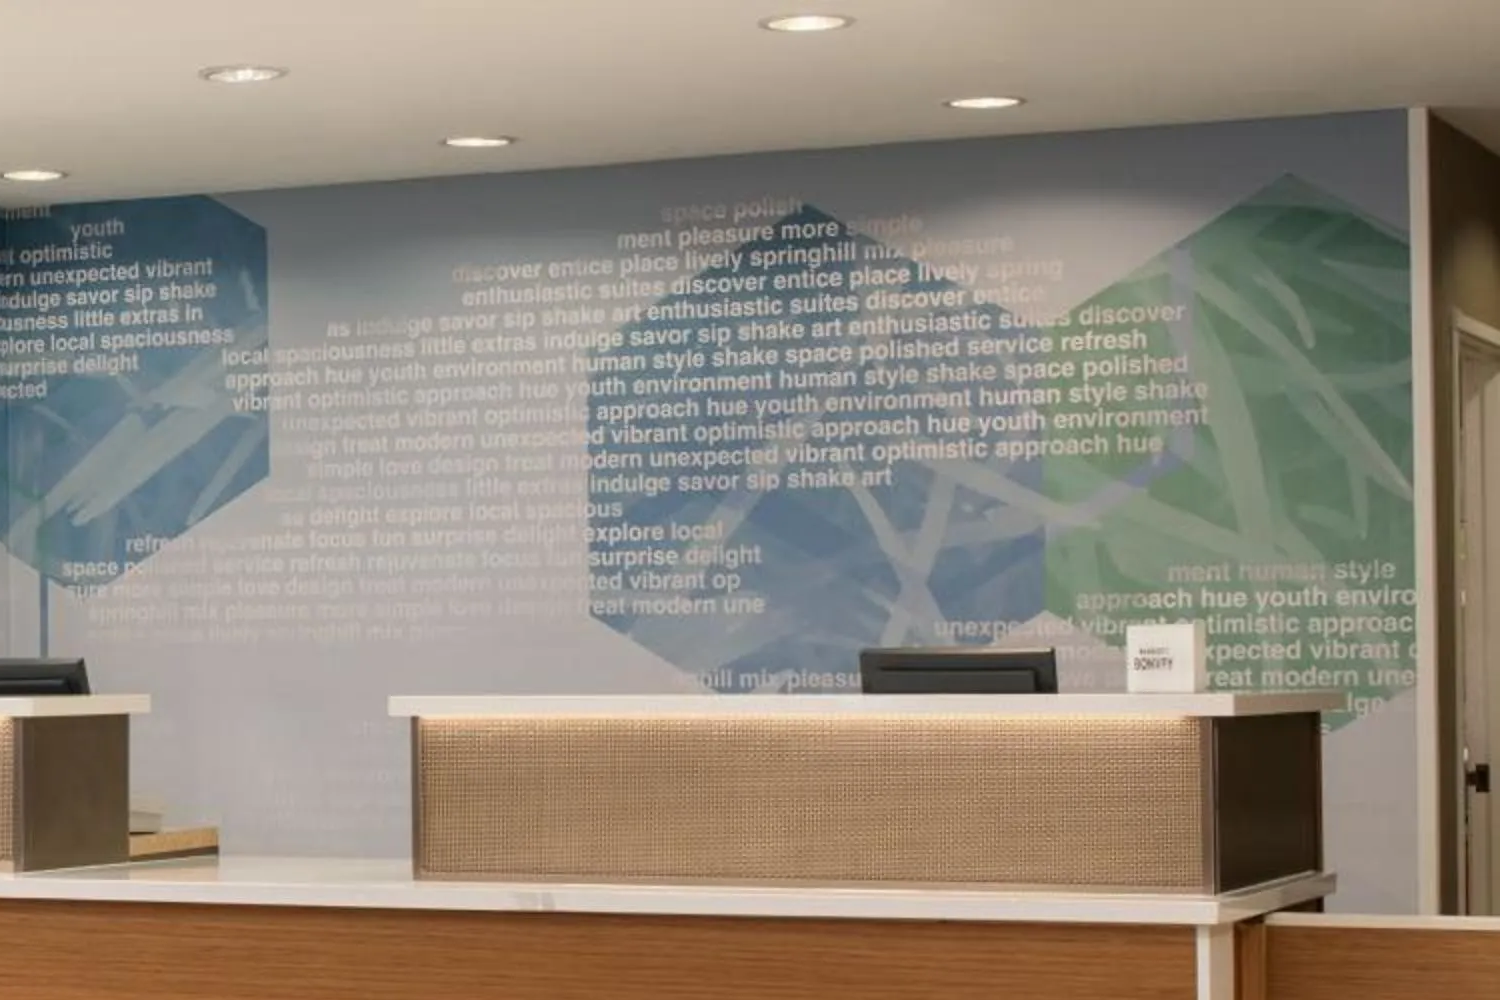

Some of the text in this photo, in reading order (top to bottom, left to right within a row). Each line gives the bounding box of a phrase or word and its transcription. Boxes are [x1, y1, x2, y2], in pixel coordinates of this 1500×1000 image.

[69, 216, 126, 242] youth
[617, 222, 839, 252] ment pleasure more
[20, 240, 114, 268] optimistic
[452, 262, 542, 282] discover
[548, 256, 614, 277] entice
[619, 253, 679, 279] place
[685, 248, 744, 273] lively
[749, 241, 857, 271] springhill
[30, 258, 214, 288] unexpected vibrant
[461, 260, 980, 306] enthusiastic suites discover entice place lively
[65, 280, 217, 307] savor sip shake
[73, 303, 204, 328] little extras in
[437, 313, 496, 331] savor
[502, 307, 535, 332] sip
[541, 304, 603, 326] shake
[612, 303, 642, 322] art
[646, 295, 783, 321] enthusiastic
[788, 293, 860, 314] suites
[865, 290, 966, 310] discover
[50, 328, 236, 354] local spaciousness
[221, 344, 268, 366] local
[420, 335, 467, 357] little
[470, 334, 537, 354] extras
[543, 329, 625, 354] indulge
[629, 329, 693, 347] savor
[696, 323, 732, 348] sip
[737, 320, 805, 341] shake
[810, 319, 843, 338] art
[849, 311, 992, 336] enthusiastic
[1078, 305, 1187, 325] discover
[72, 352, 140, 377] delight
[224, 328, 1148, 394] approach hue youth environment human style shake space polished service refresh
[232, 353, 1189, 413] vibrant optimistic approach hue youth environment human style shake space polished
[405, 407, 479, 427] vibrant
[596, 397, 700, 425] approach
[706, 396, 748, 416] hue
[754, 393, 819, 420] youth
[824, 389, 973, 412] environment
[978, 386, 1062, 406] human
[1068, 382, 1128, 408] style
[1134, 379, 1208, 401] shake
[393, 430, 476, 451] modern
[480, 424, 605, 452] unexpected
[610, 423, 689, 444] vibrant
[693, 418, 805, 446] optimistic
[810, 414, 920, 442] approach
[926, 413, 972, 433] hue
[977, 410, 1047, 437] youth
[1052, 406, 1210, 429] environment
[379, 456, 424, 476] love
[426, 453, 500, 478] design
[559, 449, 644, 470] modern
[649, 444, 779, 471] unexpected
[785, 443, 865, 463] vibrant
[871, 438, 989, 466] optimistic
[995, 434, 1109, 462] approach
[1116, 433, 1164, 453] hue
[590, 472, 672, 498] indulge
[677, 474, 741, 491] savor
[745, 469, 781, 494] sip
[786, 467, 856, 488] shake
[861, 467, 894, 486] art
[581, 519, 724, 547] explore local
[61, 544, 764, 582] space surprise delight
[1167, 559, 1397, 585] ment human style
[629, 569, 741, 593] vibrant op
[631, 593, 767, 614] modern une
[1075, 585, 1417, 614] approach hue youth enviro
[1206, 613, 1414, 638] timistic approac
[1309, 639, 1401, 659] vibrant
[738, 668, 781, 688] mix
[1206, 666, 1416, 687] reat modern une
